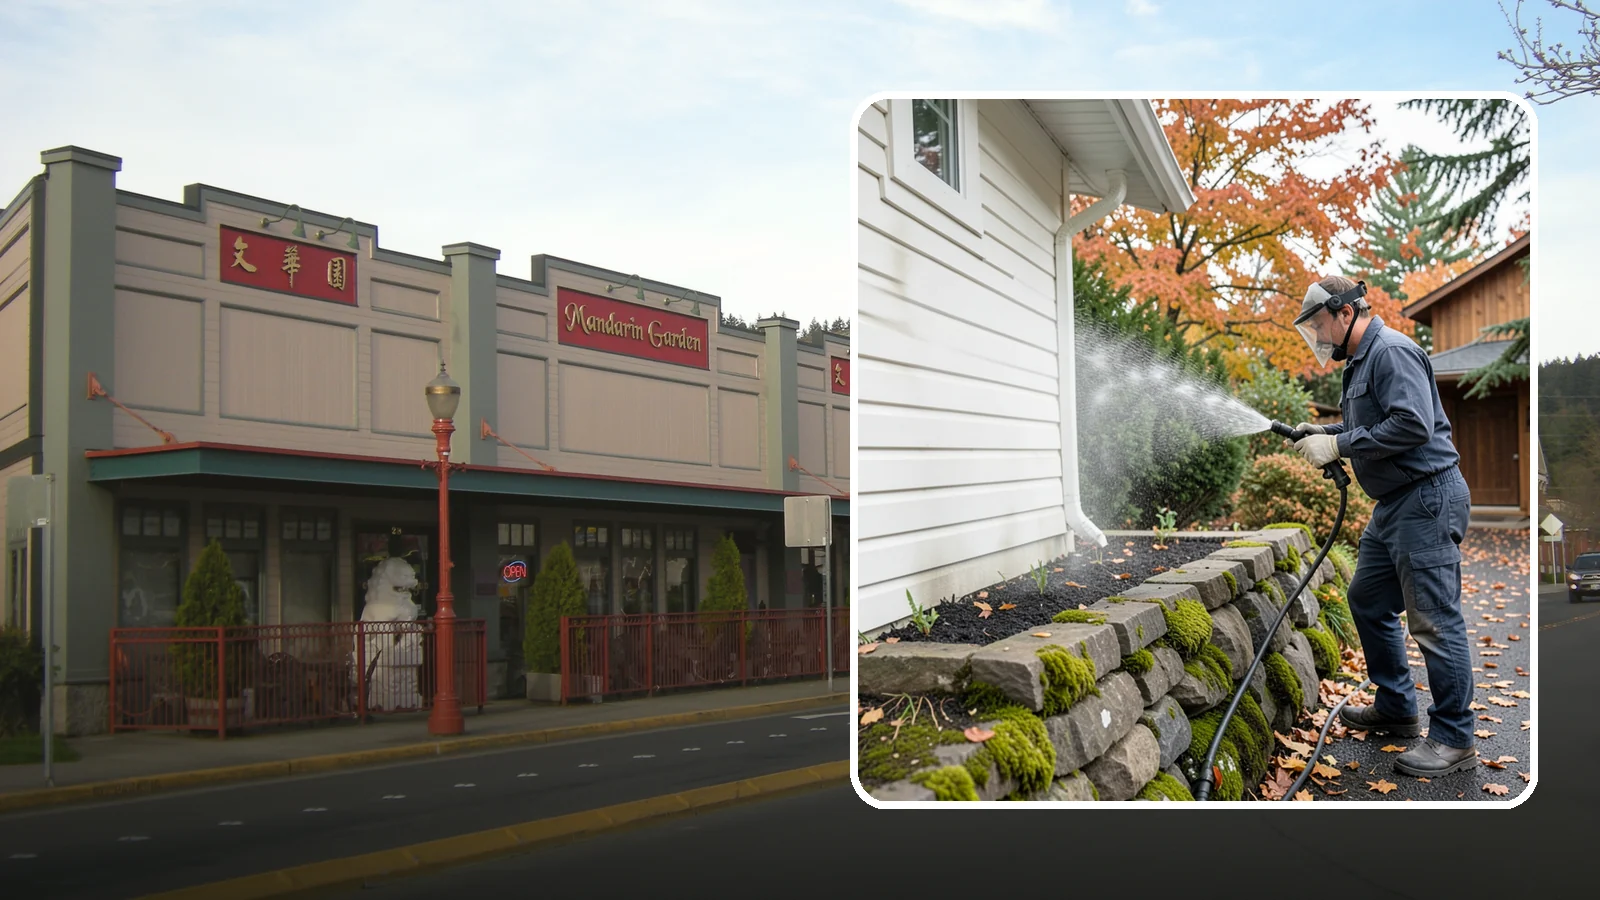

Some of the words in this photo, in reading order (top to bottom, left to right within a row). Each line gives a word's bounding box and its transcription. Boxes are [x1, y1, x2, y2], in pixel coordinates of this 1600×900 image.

[564, 302, 644, 341] Mandarin
[648, 320, 701, 352] Garden
[503, 565, 527, 578] OPEN
